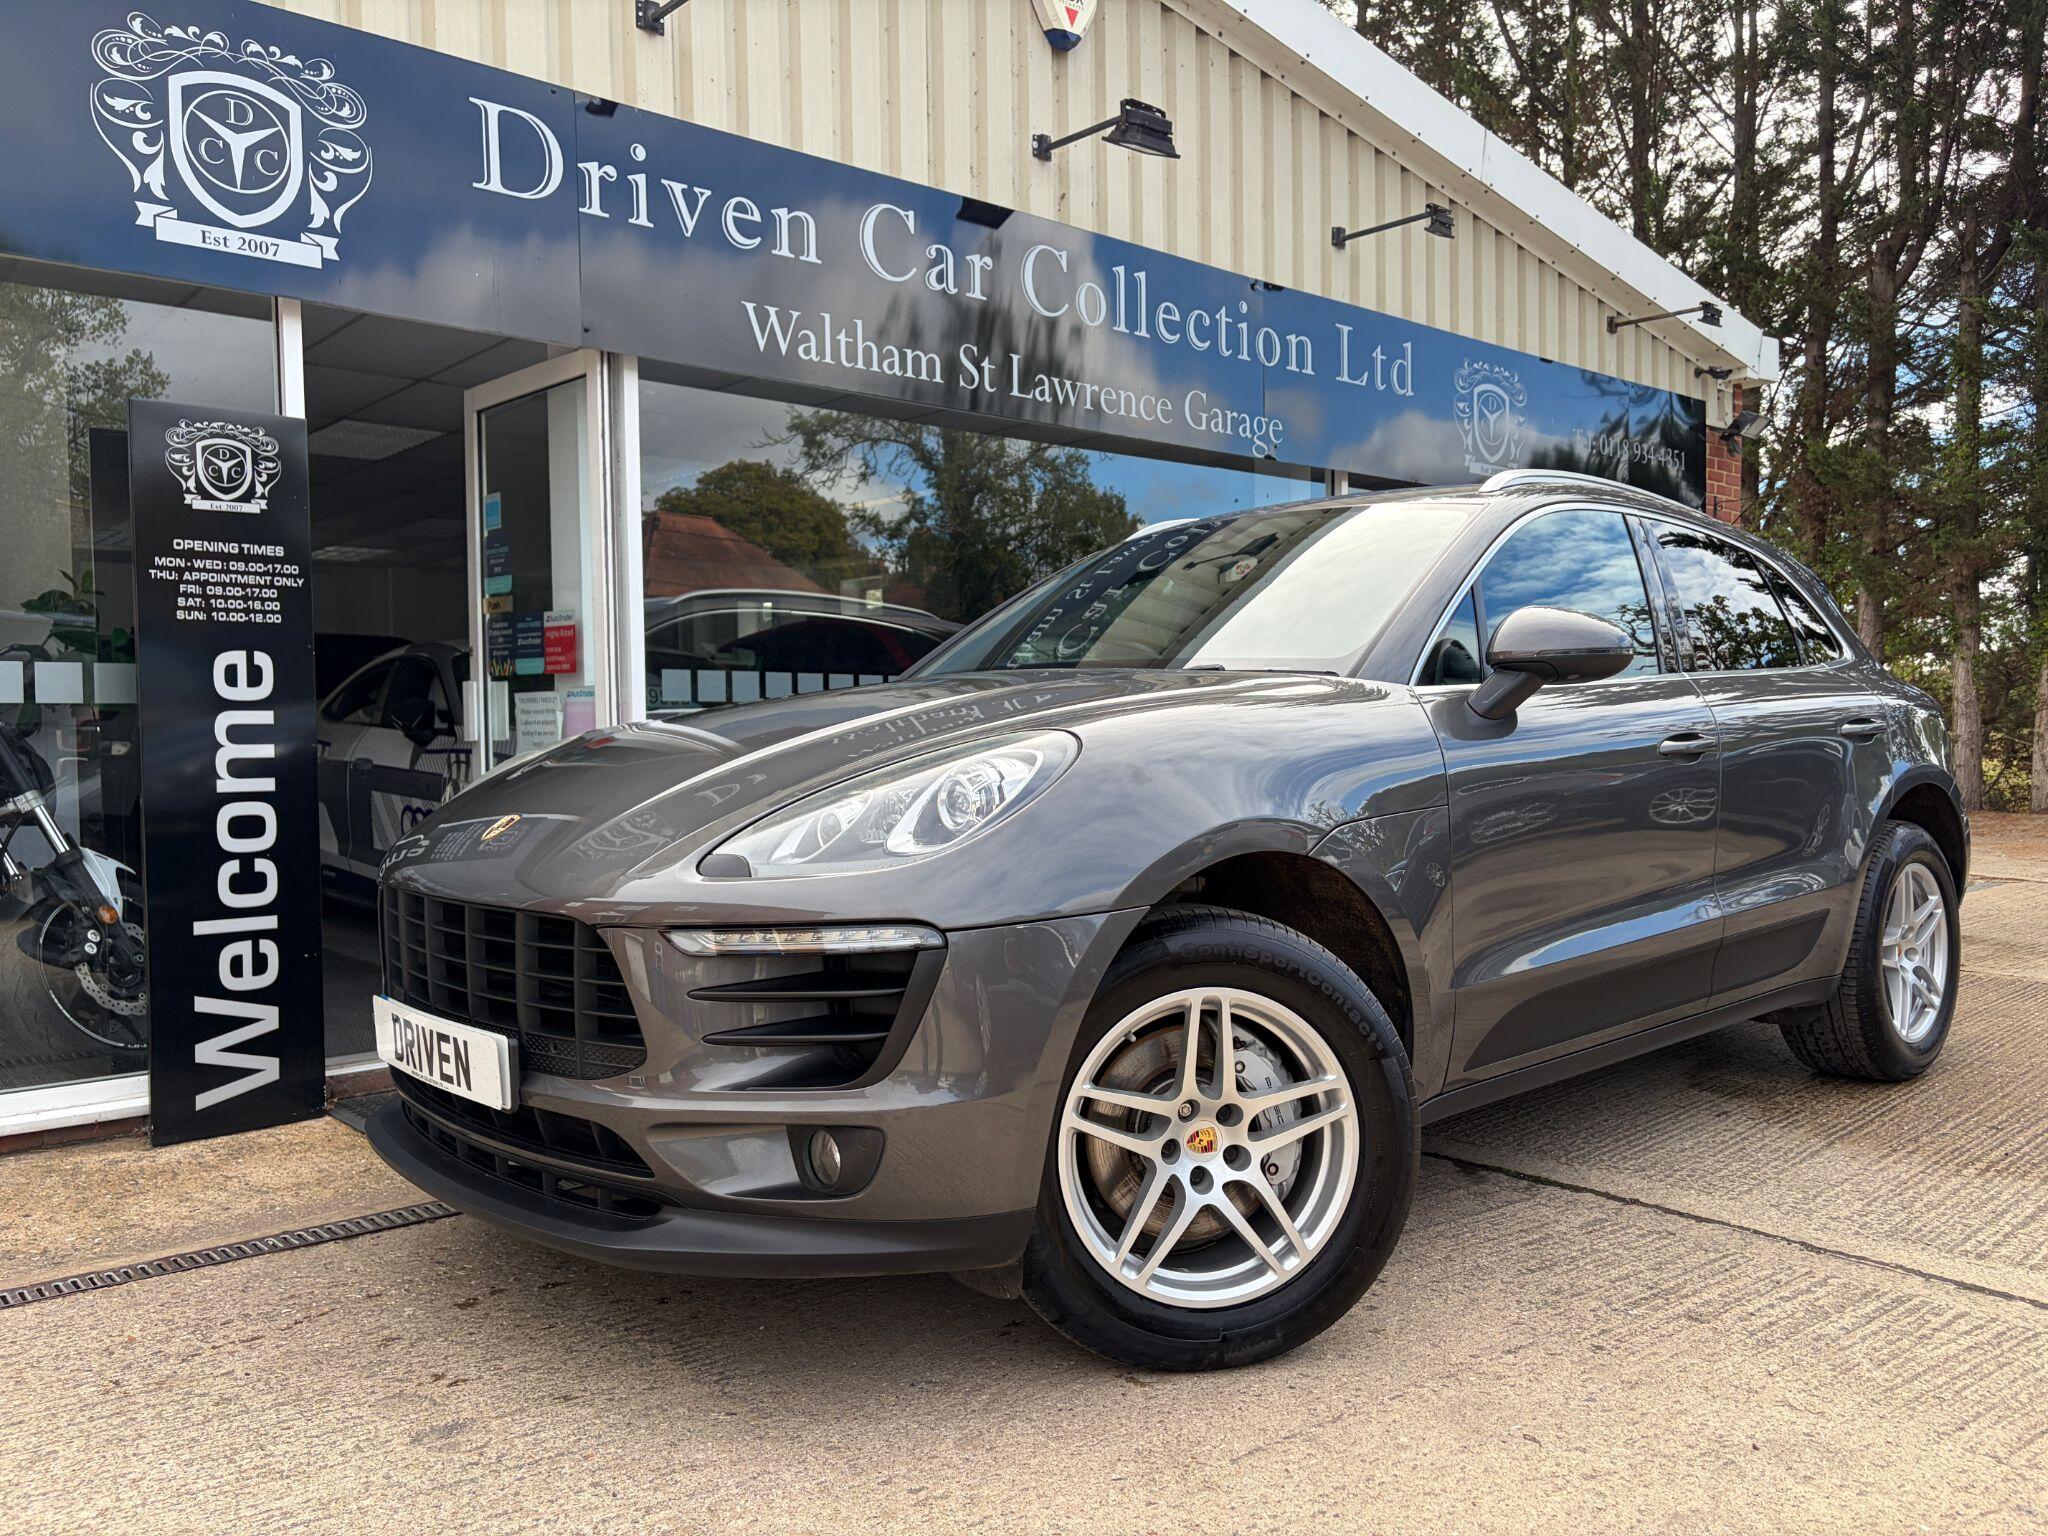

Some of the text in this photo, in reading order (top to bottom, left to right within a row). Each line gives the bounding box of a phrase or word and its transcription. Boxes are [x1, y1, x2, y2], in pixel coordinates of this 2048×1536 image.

[225, 97, 253, 125] D
[199, 137, 278, 175] C C
[201, 229, 280, 258] Est 2007
[469, 96, 1415, 397] Driven Car Collection Ltd
[740, 300, 1284, 458] Waltham St Lawrence Garage
[1600, 434, 1629, 460] 0118
[1633, 442, 1655, 465] 934
[1658, 447, 1686, 471] 4351
[173, 539, 284, 557] OPENING TIMES
[149, 569, 304, 588] THU: APPOINTMENT ONLY
[154, 556, 186, 568] MON
[229, 561, 299, 575] 09.00-17.00
[177, 597, 280, 611] SAT: 10.00-16.00
[179, 584, 277, 598] FRI: 09.00-17.00
[176, 610, 282, 623] SUN: 10.00-12.00
[193, 649, 280, 1112] Welcome
[391, 1012, 472, 1092] DRIVEN
